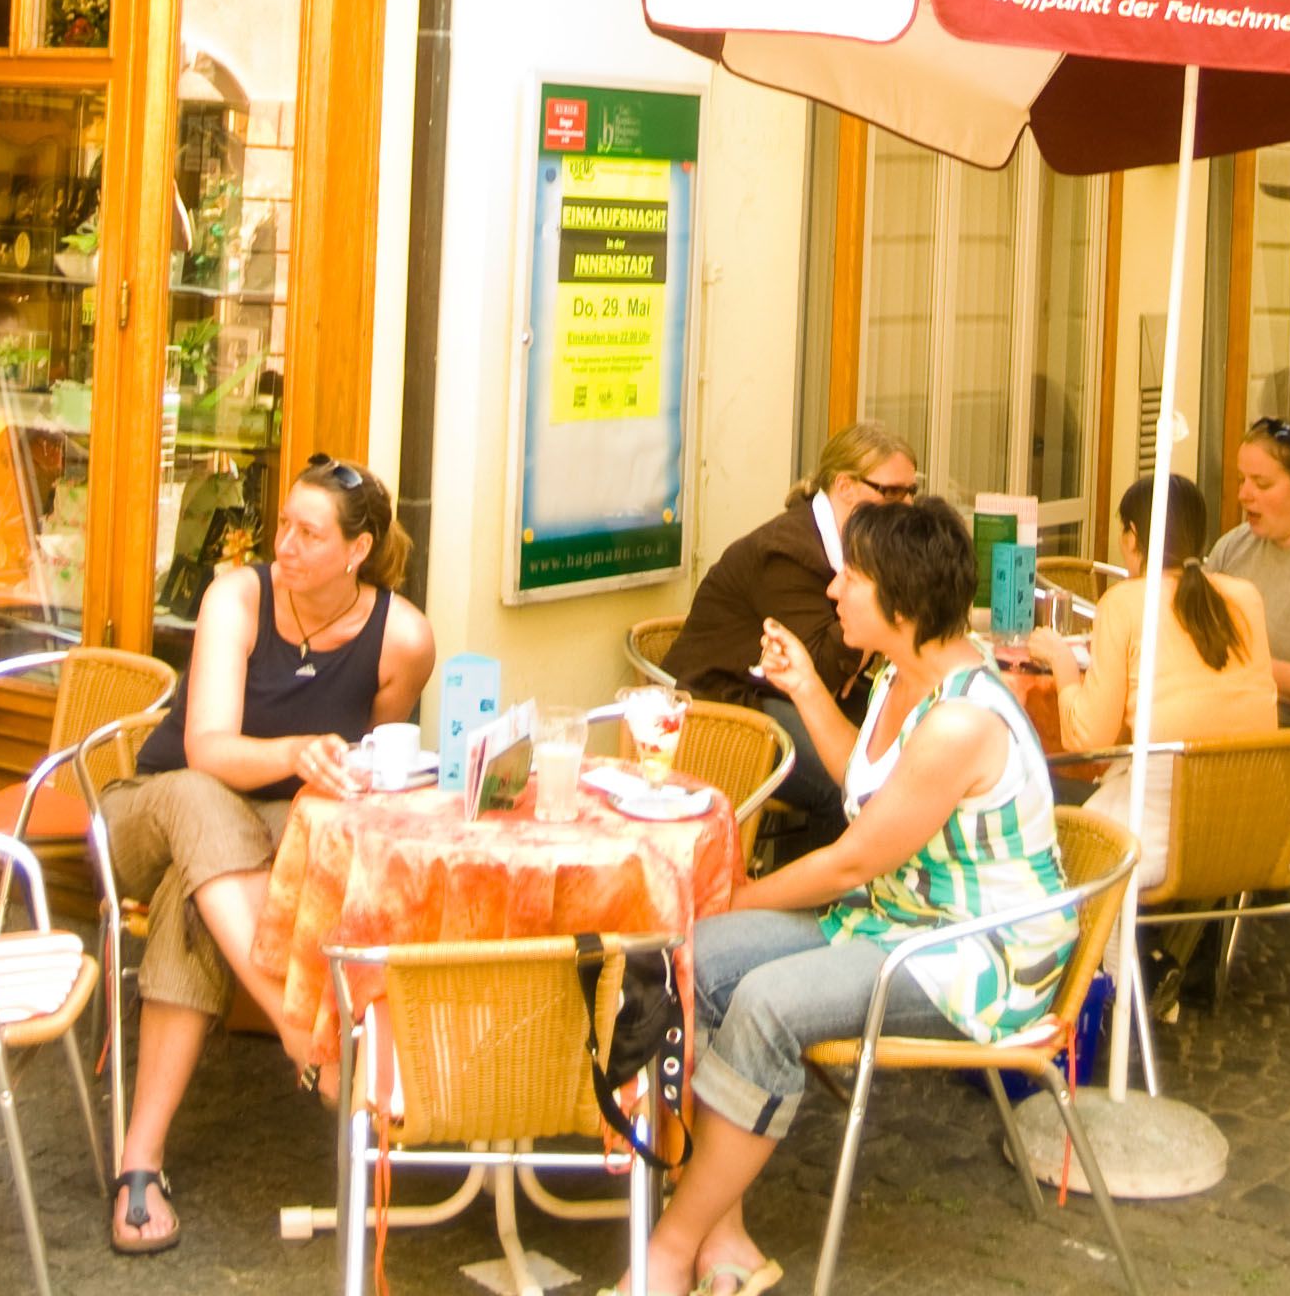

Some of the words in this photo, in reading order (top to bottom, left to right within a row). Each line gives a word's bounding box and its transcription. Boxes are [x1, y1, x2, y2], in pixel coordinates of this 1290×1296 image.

[562, 205, 667, 232] EINKAUFSNACHT
[574, 254, 653, 278] INNENSTADT
[628, 296, 651, 317] Mai
[529, 540, 670, 574] www.hagmann.co.at
